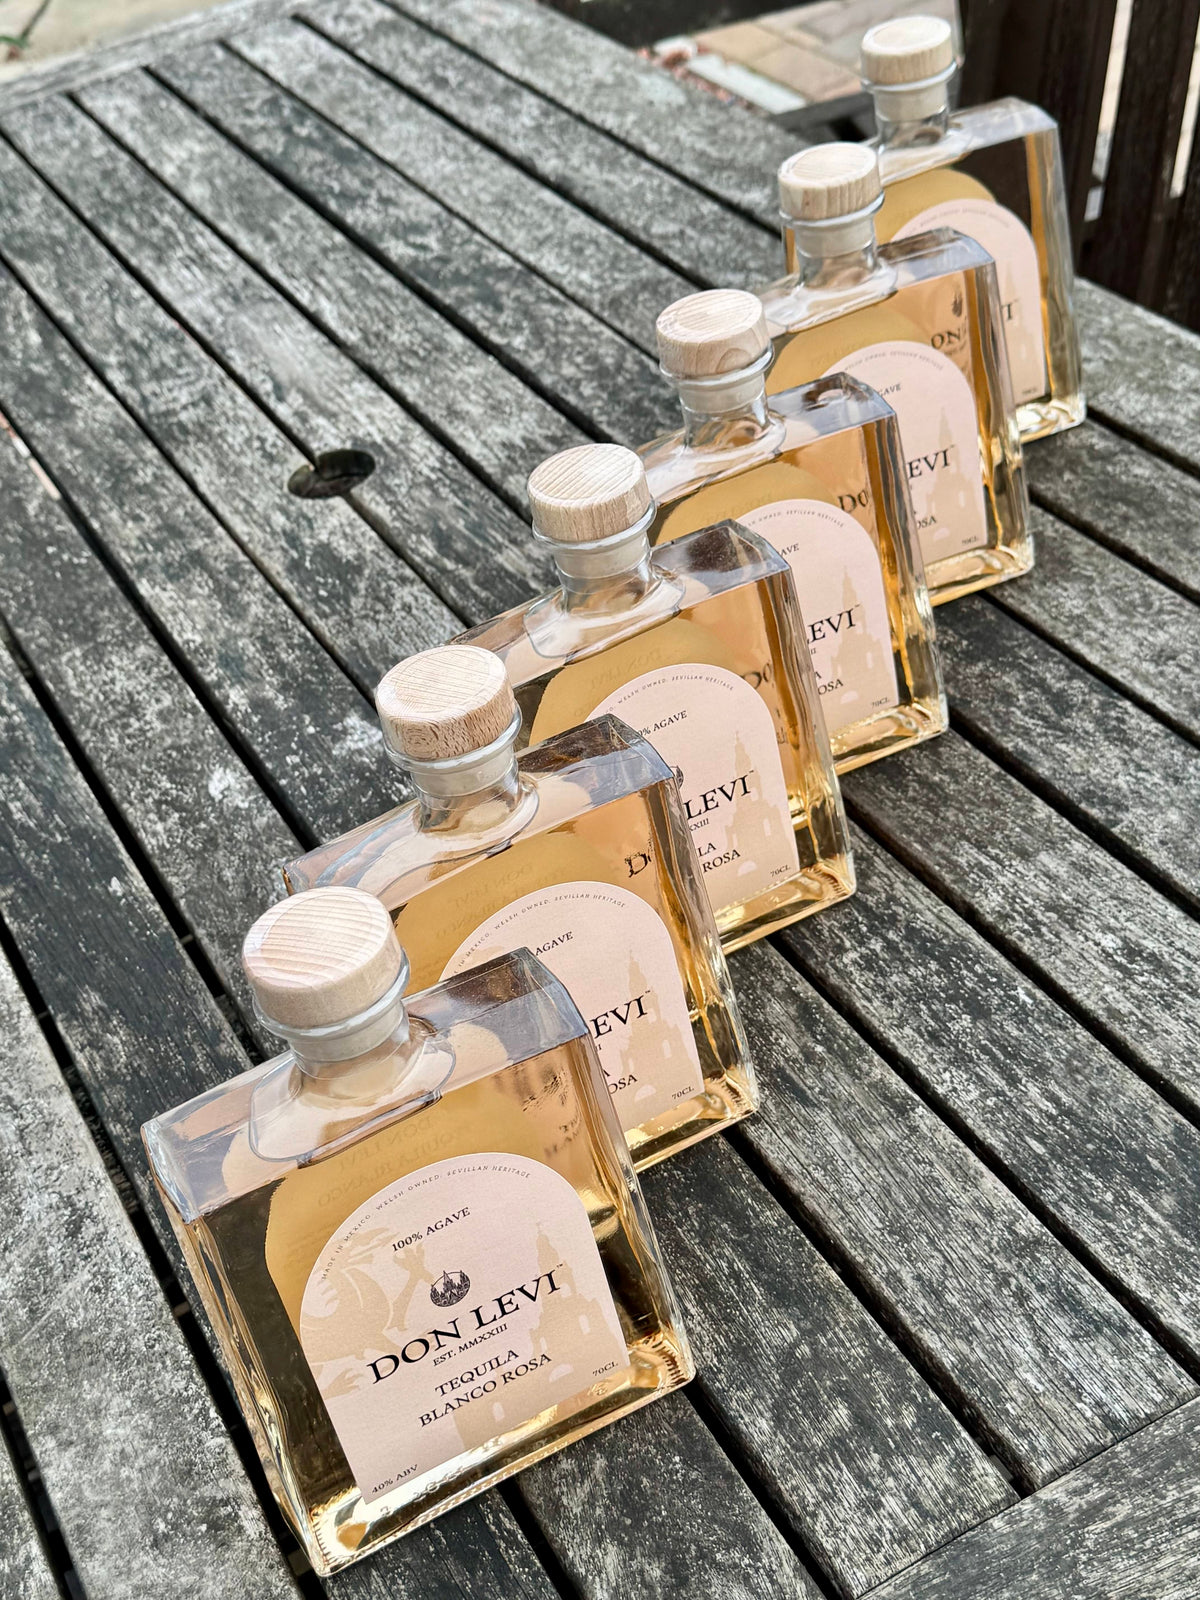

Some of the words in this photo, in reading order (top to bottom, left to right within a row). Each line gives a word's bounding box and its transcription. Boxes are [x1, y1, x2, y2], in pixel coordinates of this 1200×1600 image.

[817, 678, 844, 695] OSA
[653, 710, 688, 732] AGAVE
[702, 849, 741, 873] ROSA
[535, 931, 574, 956] AGAVE
[492, 1165, 531, 1179] HERITAGE
[392, 1230, 424, 1253] 100%
[425, 1206, 471, 1236] AGAVE
[366, 1317, 463, 1386] DON
[432, 1350, 457, 1368] EST.
[457, 1323, 509, 1353] MMXXIII
[434, 1349, 520, 1397] TEQUILA
[592, 1361, 619, 1378] 70CL
[417, 1381, 500, 1429] BLANCO
[500, 1353, 553, 1387] ROSA
[372, 1477, 395, 1494] 40%
[396, 1463, 419, 1481] ABV
